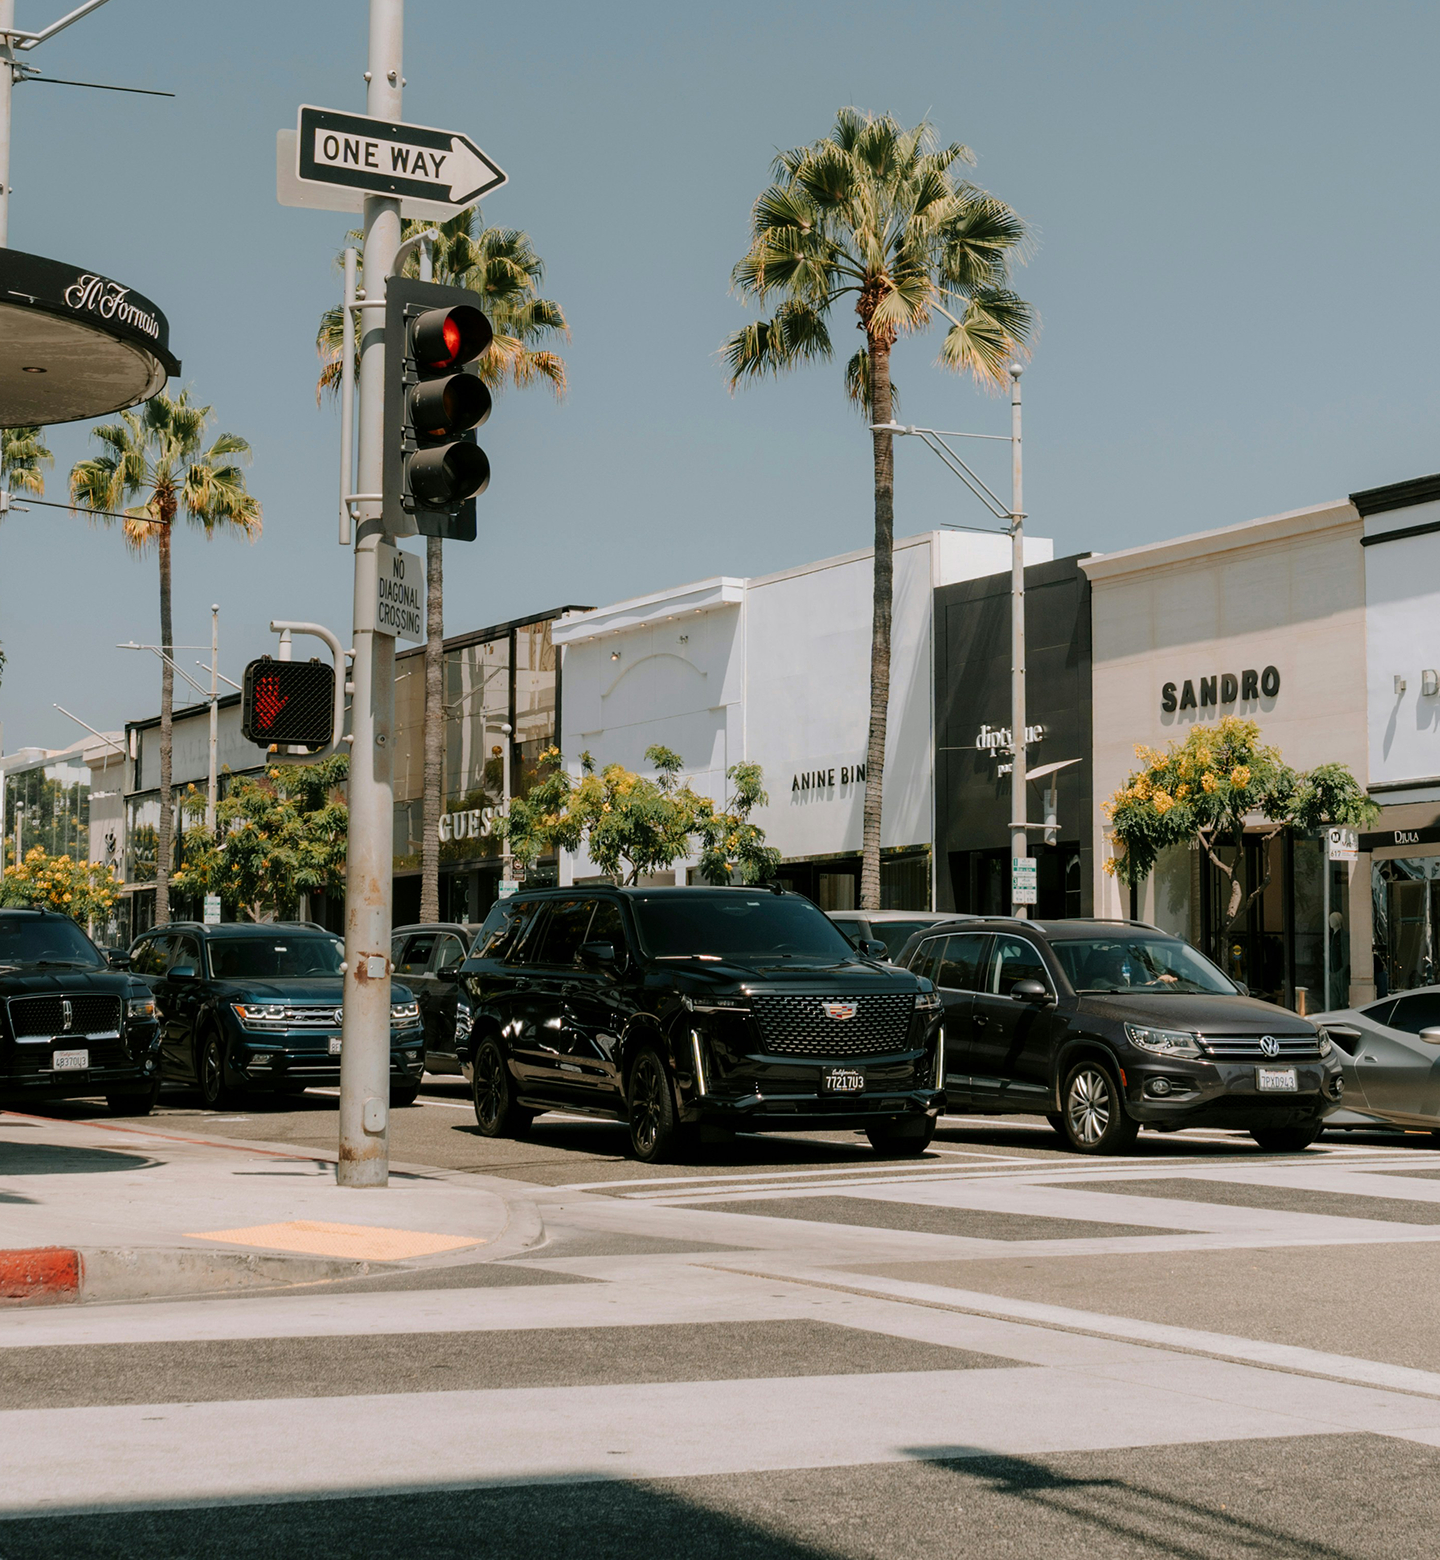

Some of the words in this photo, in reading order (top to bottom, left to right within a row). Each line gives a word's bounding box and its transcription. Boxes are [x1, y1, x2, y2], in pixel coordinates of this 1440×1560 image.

[323, 135, 379, 168] ONE
[391, 146, 447, 178] WAY
[65, 274, 104, 309] Il
[100, 282, 159, 339] Fornaio
[393, 557, 405, 580] NO
[379, 577, 420, 610] DIAGONAL
[379, 601, 420, 634] CROSSING
[1161, 665, 1280, 713] SANDRO
[976, 725, 1043, 758] diptyue
[792, 768, 835, 791] ANINE
[841, 764, 866, 784] BIN
[825, 1075, 864, 1089] 77217U3
[1261, 1076, 1294, 1088] 7PXD943
